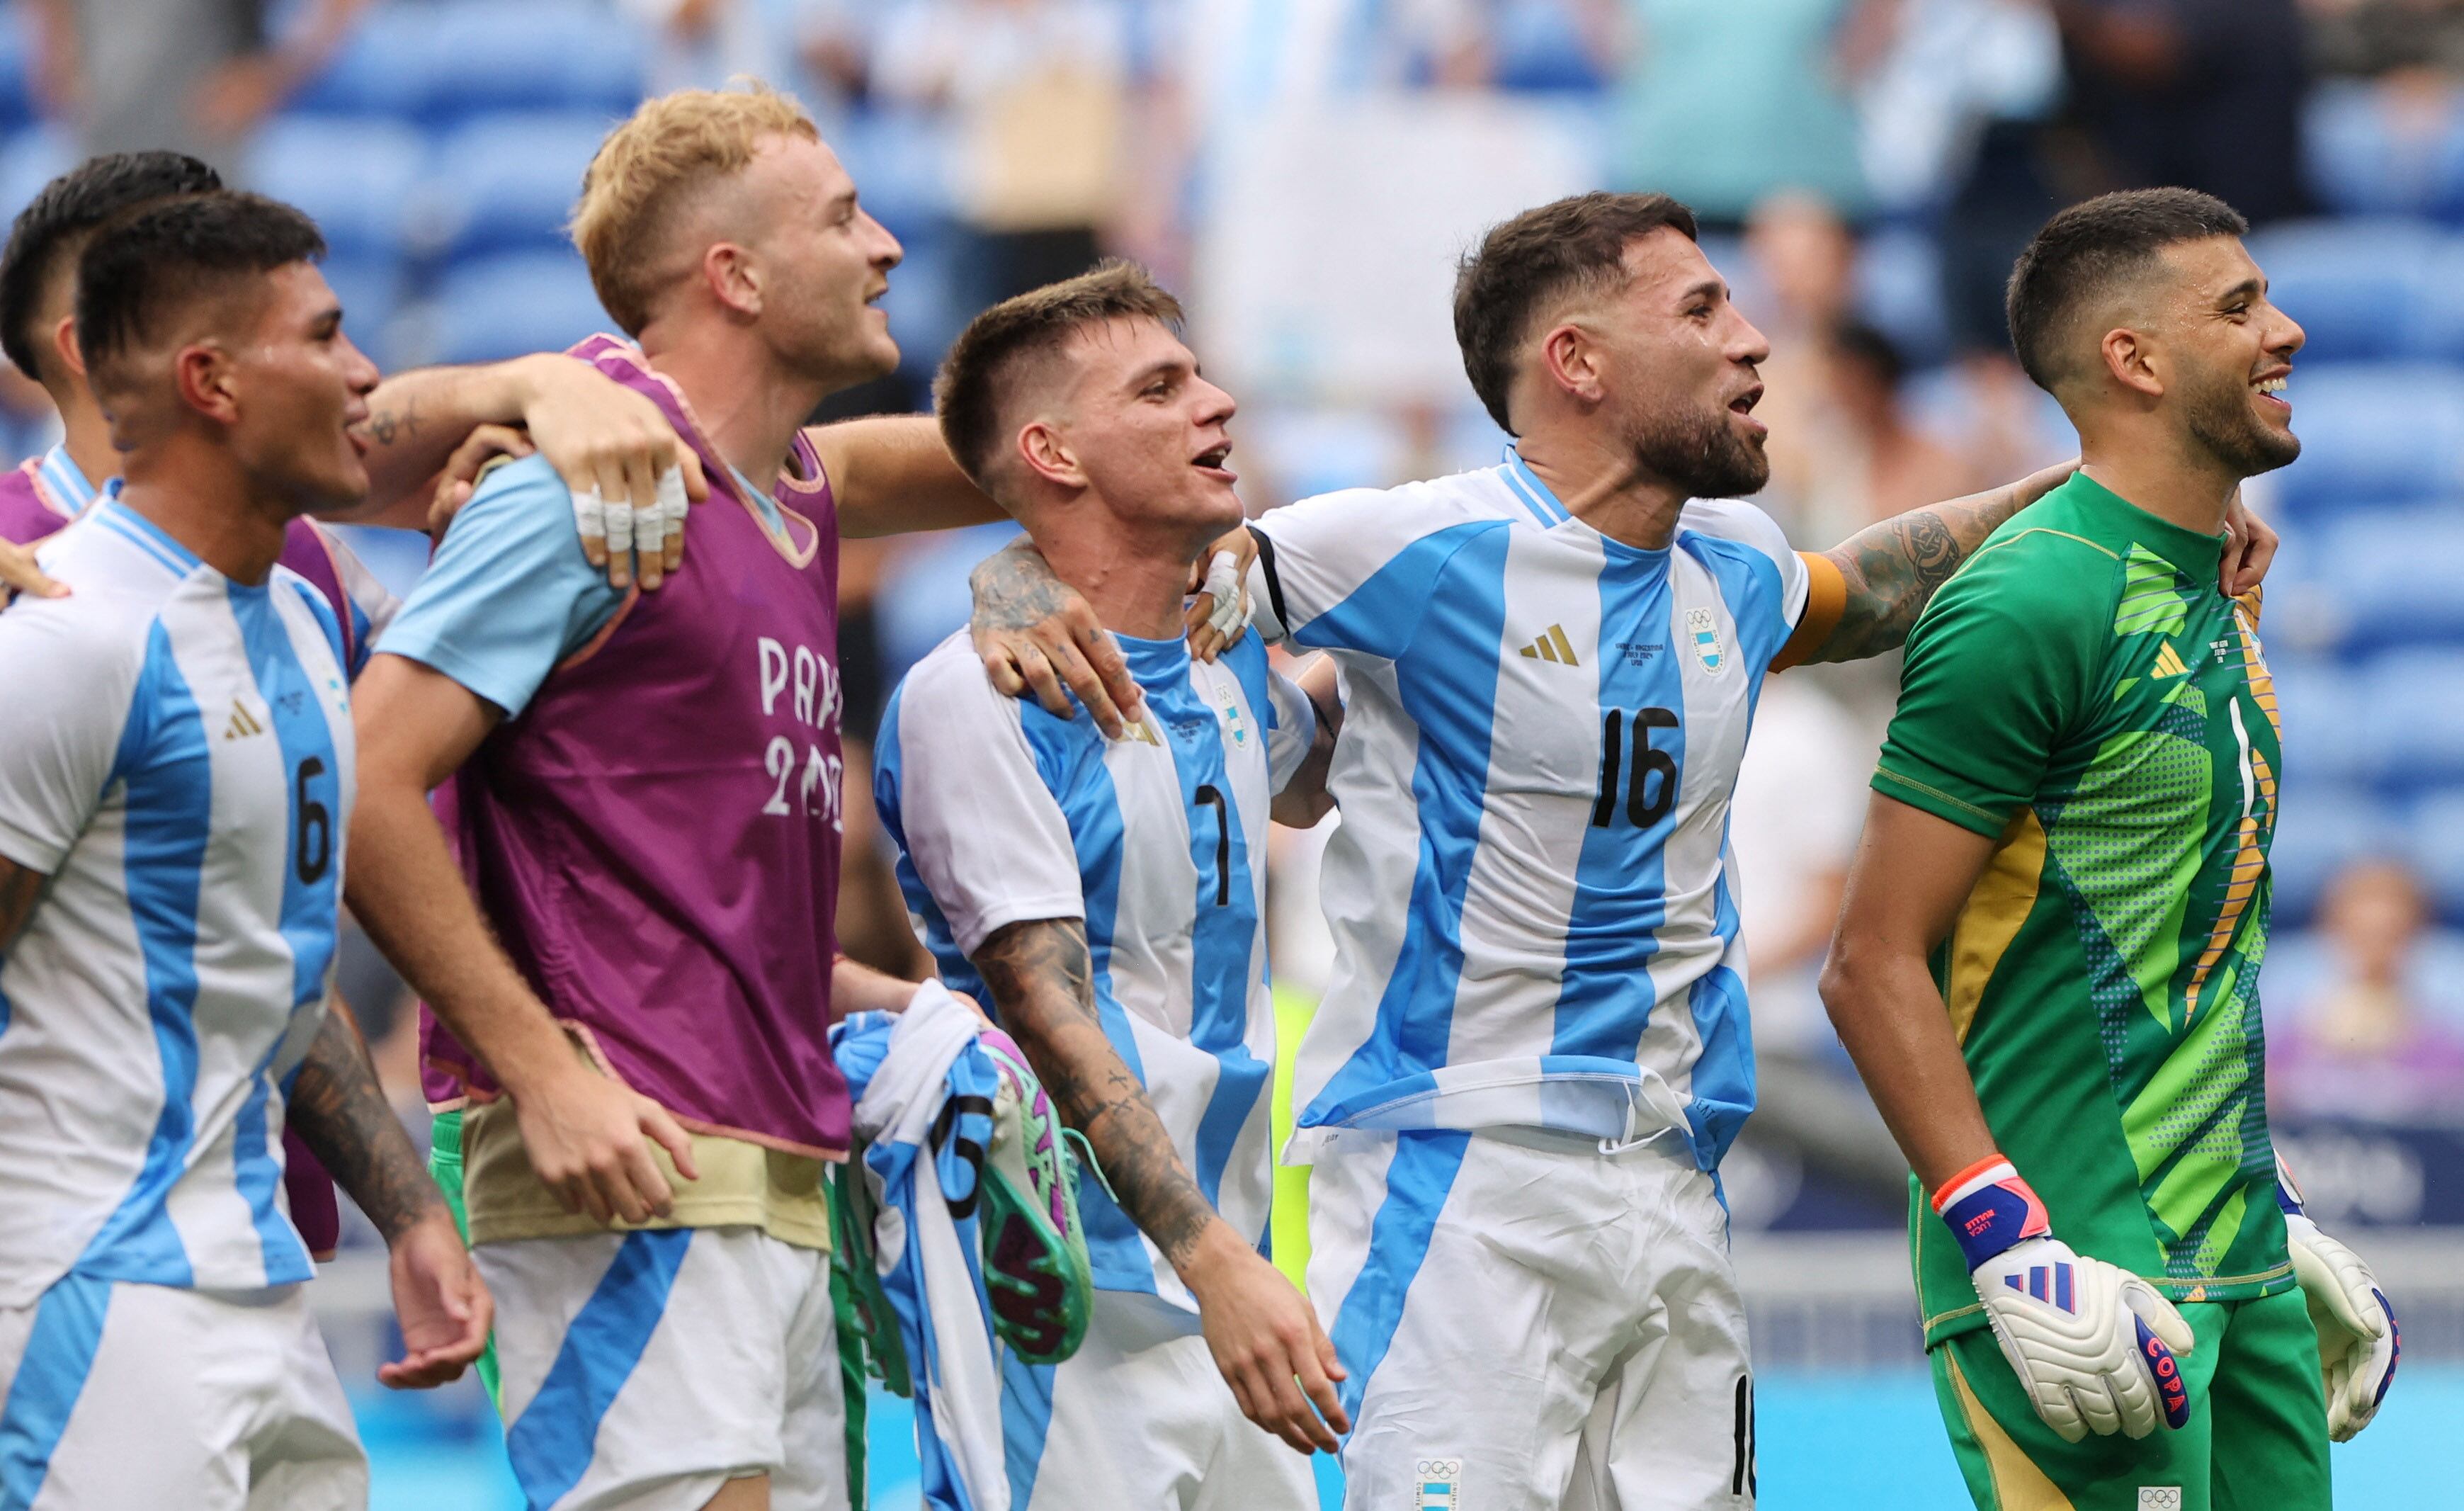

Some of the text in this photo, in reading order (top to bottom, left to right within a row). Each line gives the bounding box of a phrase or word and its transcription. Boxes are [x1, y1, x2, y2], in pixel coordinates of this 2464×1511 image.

[297, 754, 331, 885] 6
[1592, 707, 1679, 828] 16
[1194, 784, 1229, 907] 7
[2147, 1337, 2186, 1413] COPA
